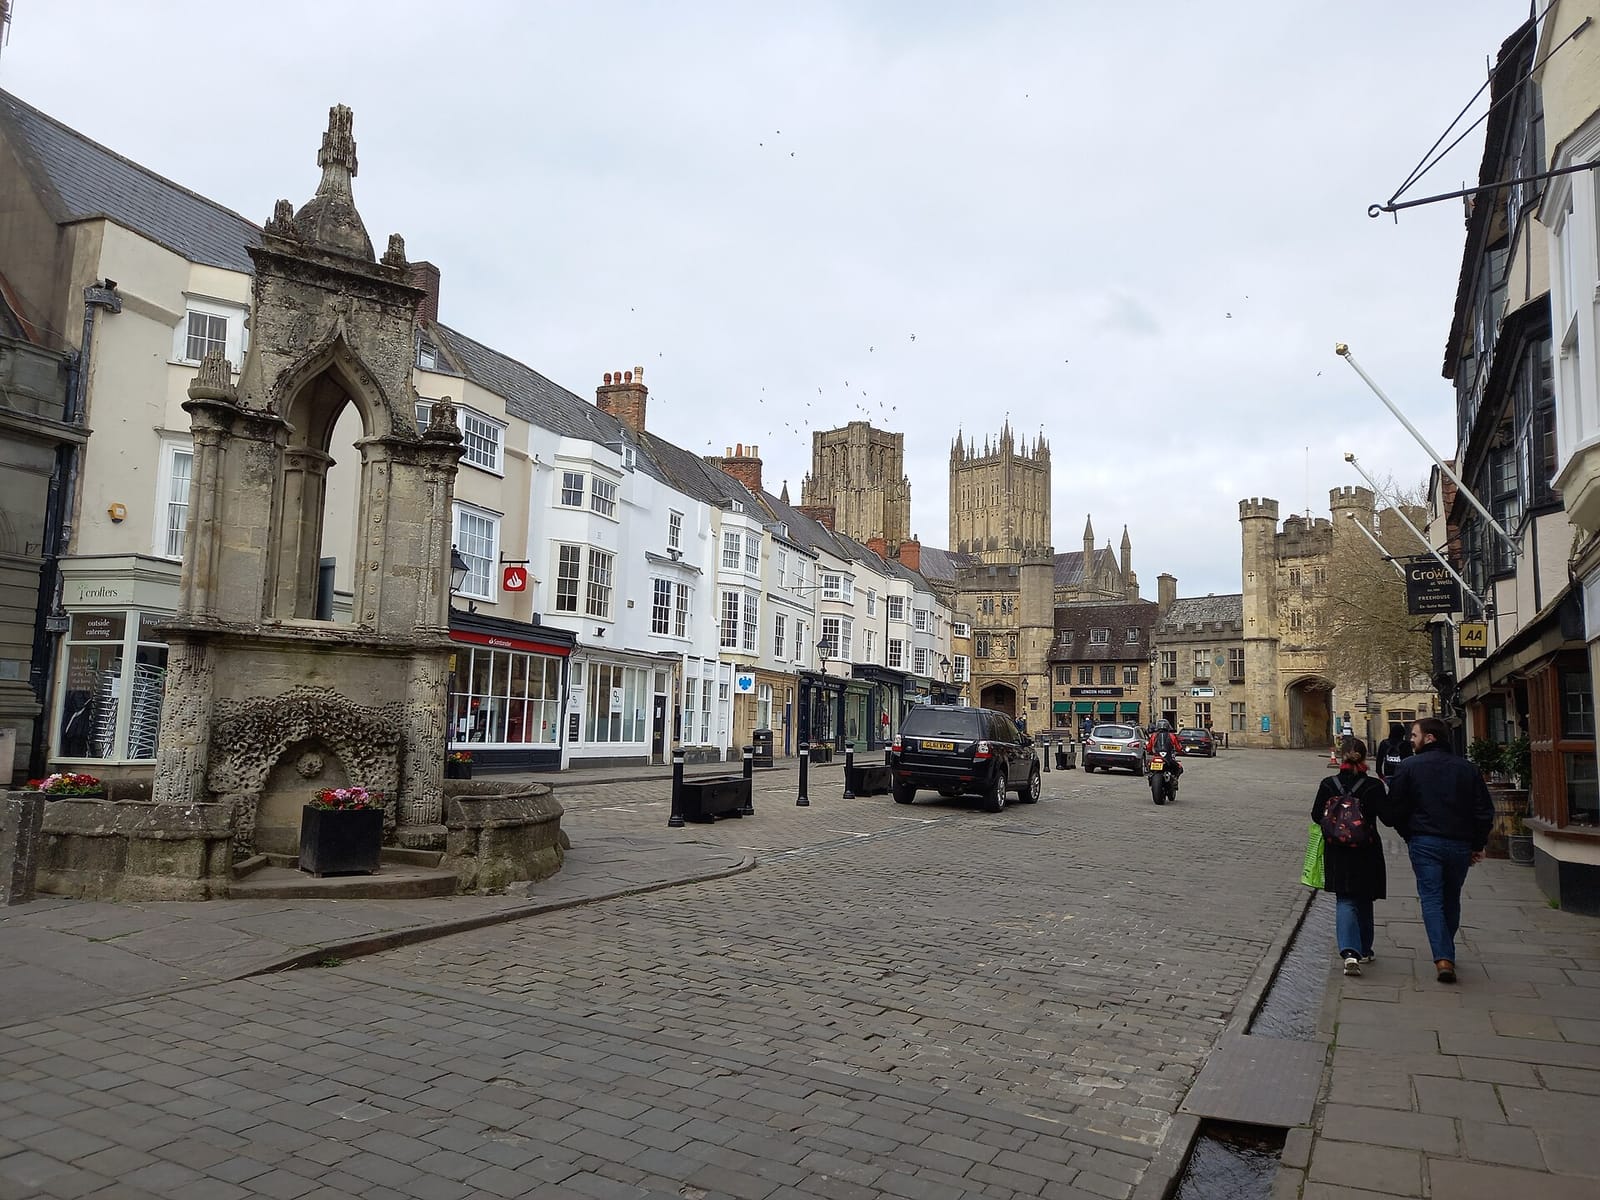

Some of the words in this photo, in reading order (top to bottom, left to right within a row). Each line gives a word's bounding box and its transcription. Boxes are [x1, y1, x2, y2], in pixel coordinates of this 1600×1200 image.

[87, 618, 110, 627] outside
[85, 628, 111, 638] catering
[1465, 629, 1482, 641] AA
